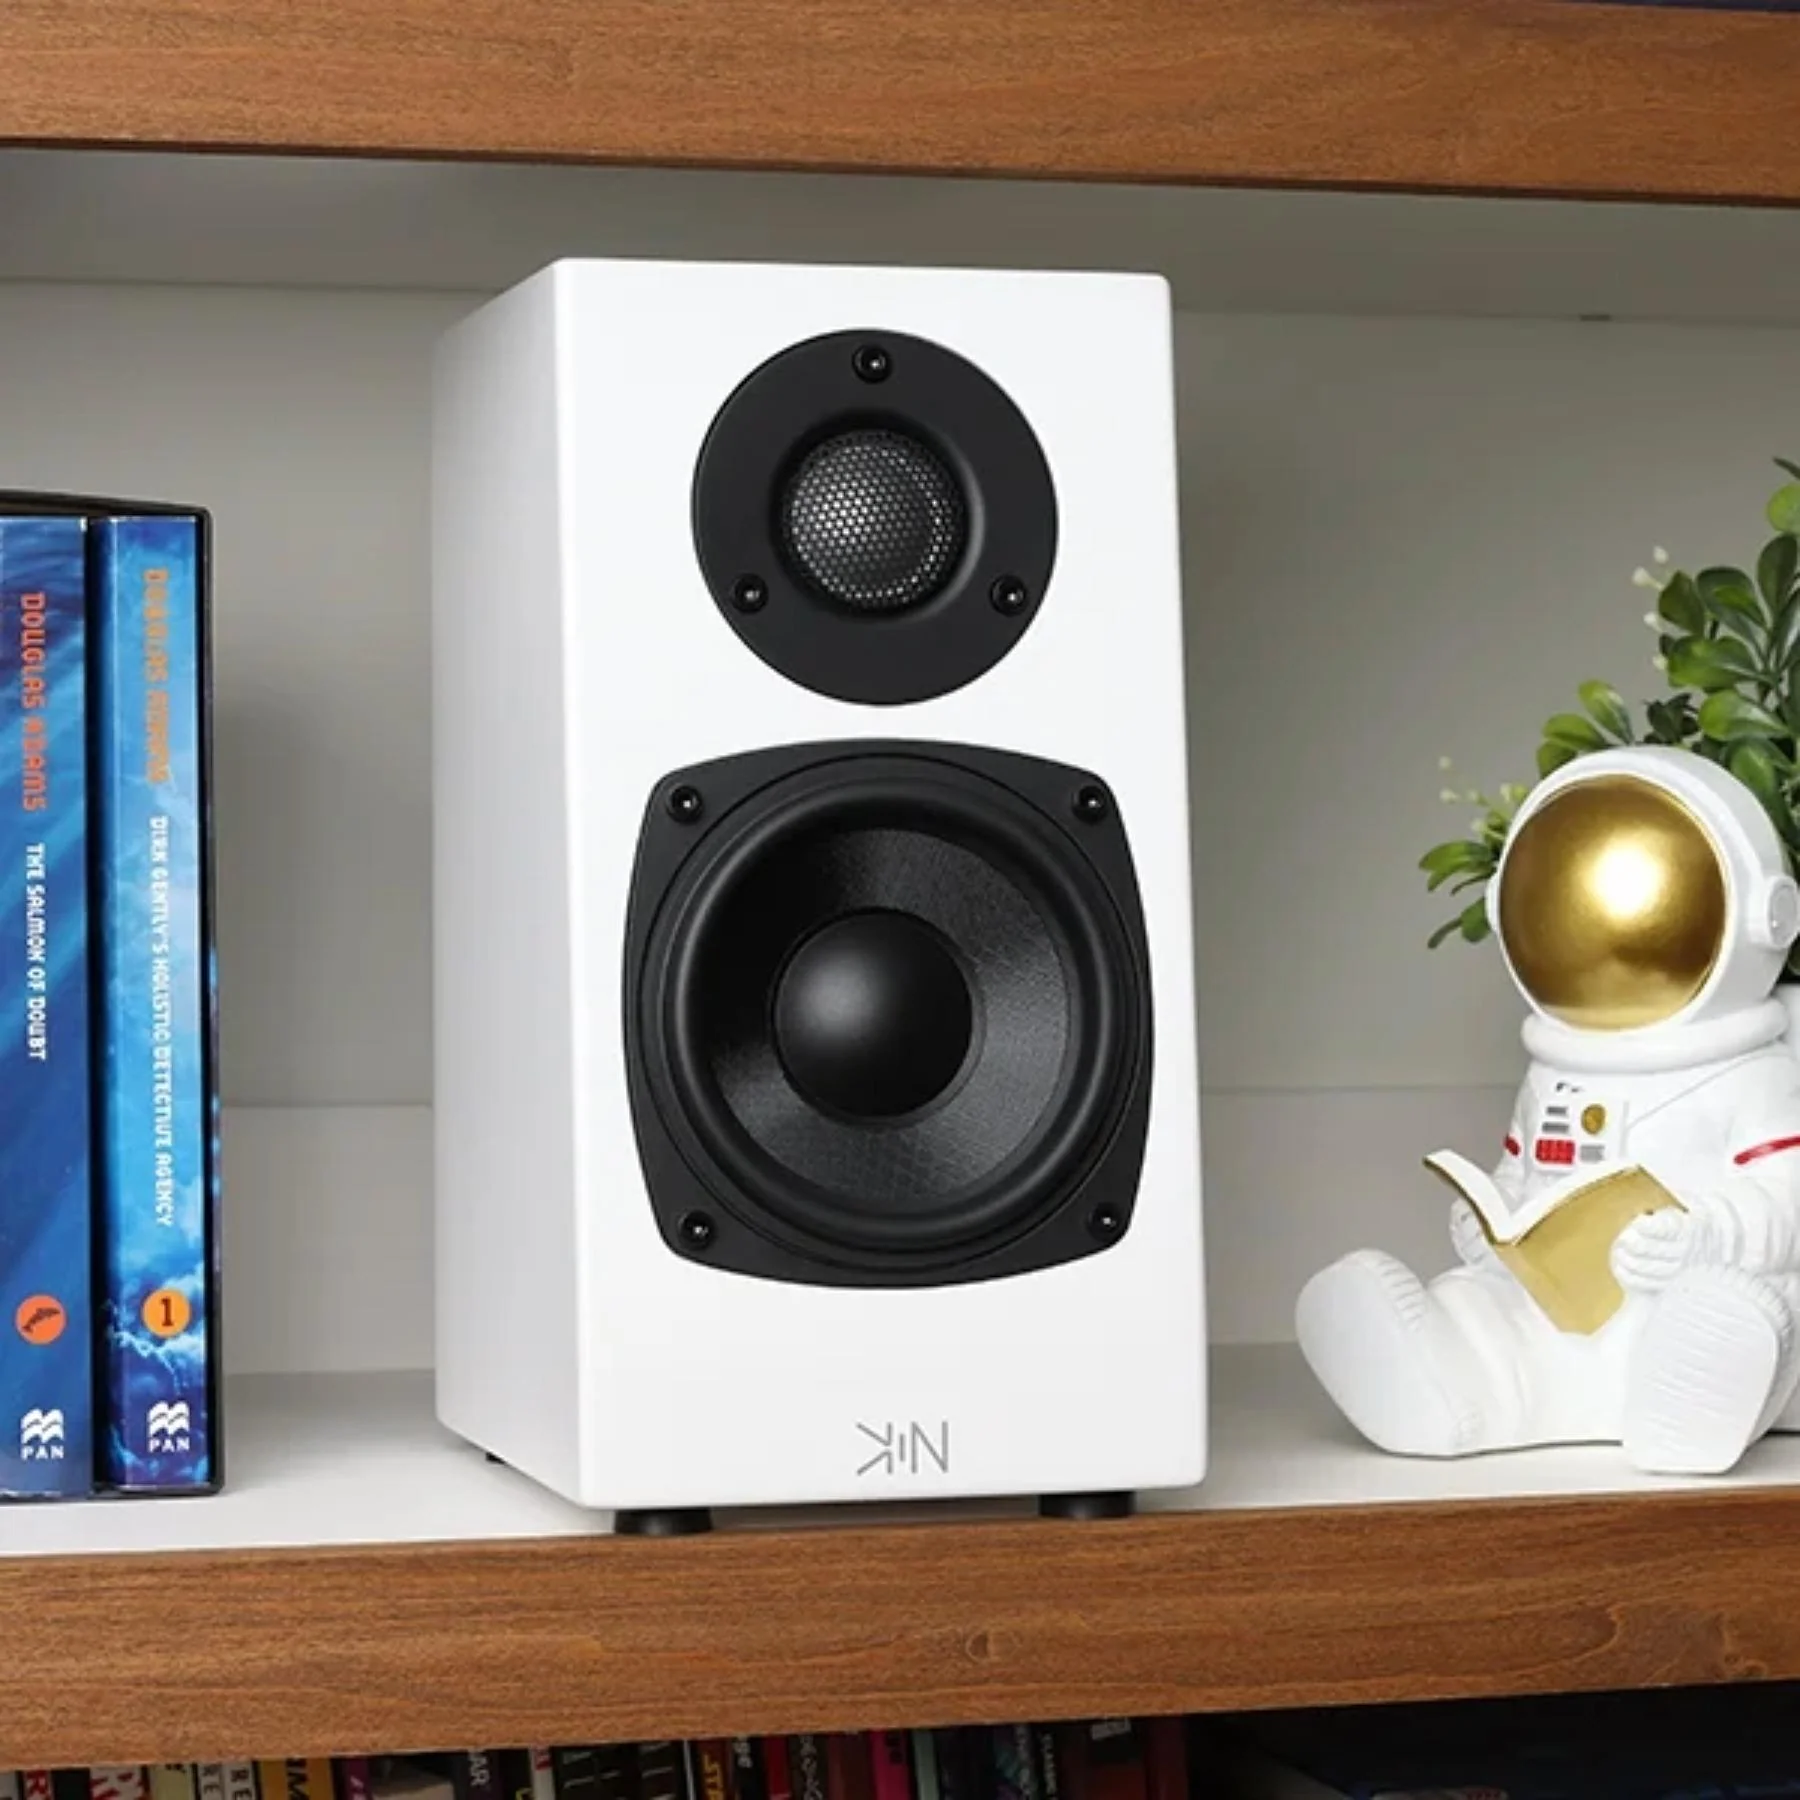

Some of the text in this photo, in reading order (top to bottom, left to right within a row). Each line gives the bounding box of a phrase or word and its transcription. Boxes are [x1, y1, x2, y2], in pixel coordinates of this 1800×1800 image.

[143, 567, 169, 682] DOUGLAS
[20, 593, 49, 812] DOUGLAS ADAMS
[26, 843, 47, 1061] THE SALMON OF DOUBT
[149, 815, 174, 1227] DIRK GENTLY'S HOLISTIC DETECTIVE AGENCY
[161, 1298, 174, 1327] 1
[20, 1445, 65, 1461] PAN
[149, 1437, 190, 1453] PAN
